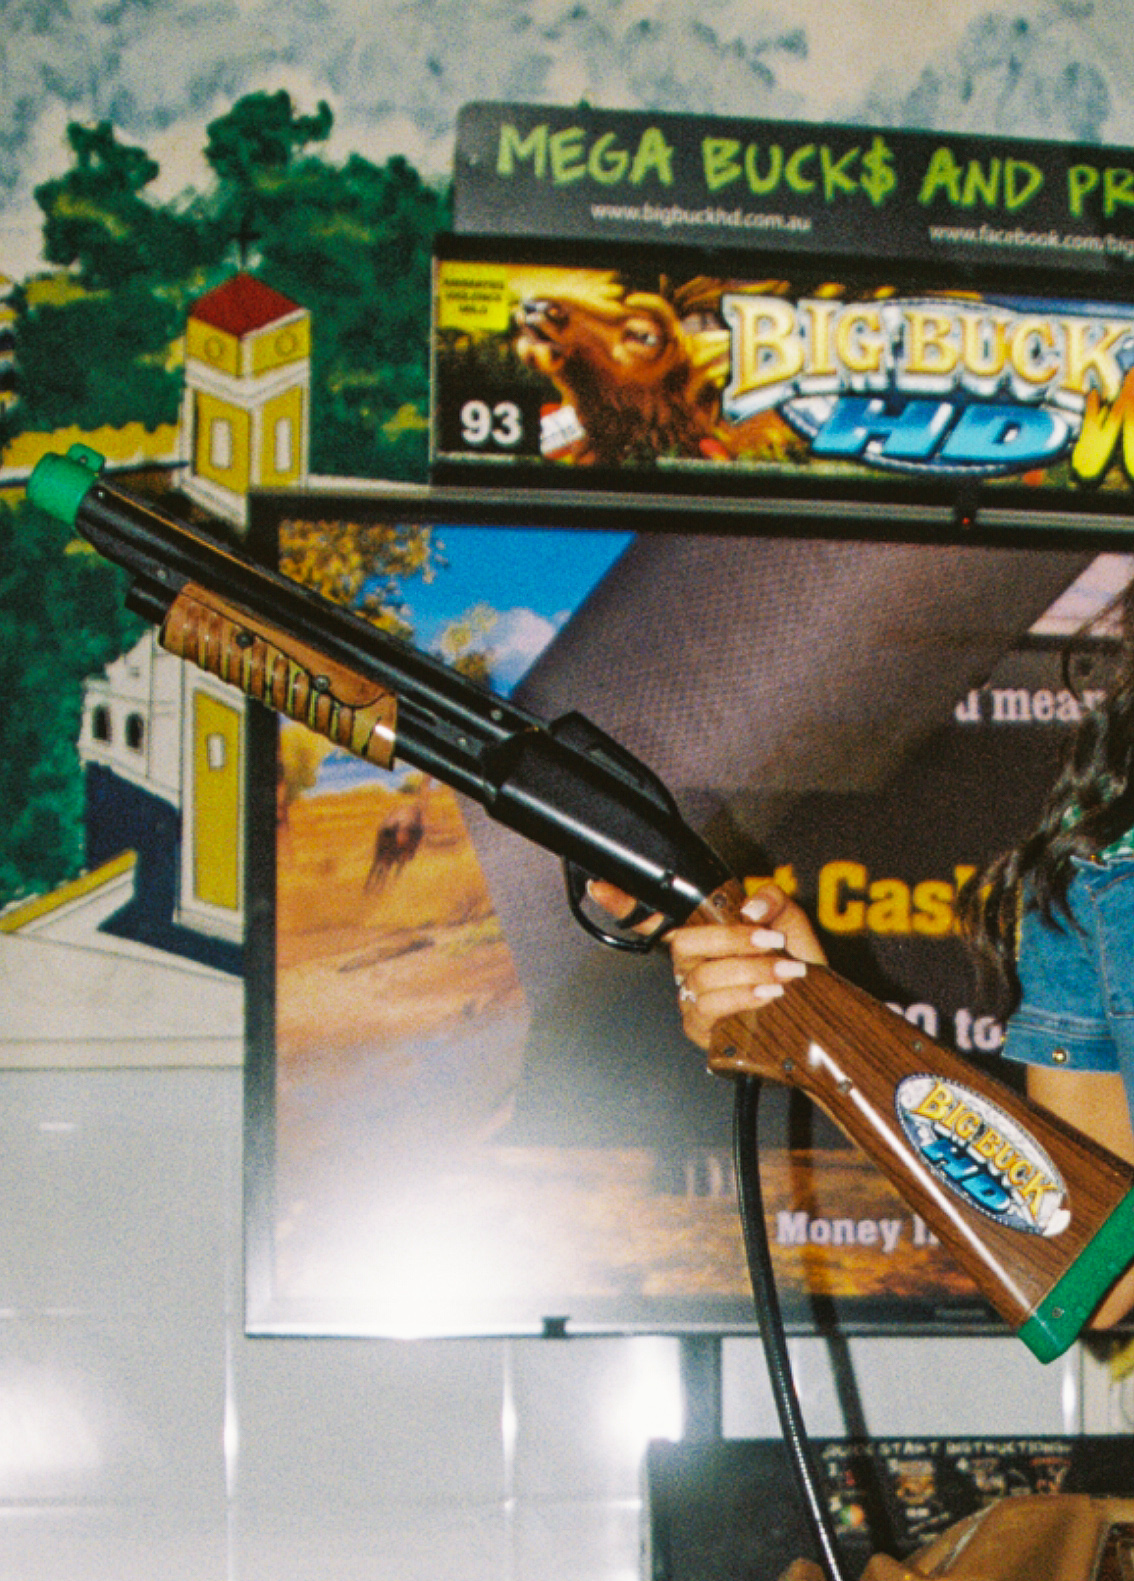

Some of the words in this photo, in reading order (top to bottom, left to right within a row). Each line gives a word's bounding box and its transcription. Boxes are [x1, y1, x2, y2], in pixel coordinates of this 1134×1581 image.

[496, 123, 674, 187] MEGA
[701, 134, 896, 207] BUCK$
[917, 146, 1043, 211] AND
[591, 202, 812, 232] www.bigbuckhd.com.au
[727, 297, 889, 404] BIG
[461, 400, 524, 446] 93
[811, 395, 1071, 465] HD
[818, 860, 991, 935] Cas
[953, 1007, 1002, 1050] to
[911, 1078, 983, 1143] BIG
[969, 1126, 1058, 1221] BUCK
[920, 1136, 1012, 1216] HD
[776, 1210, 901, 1253] Money
